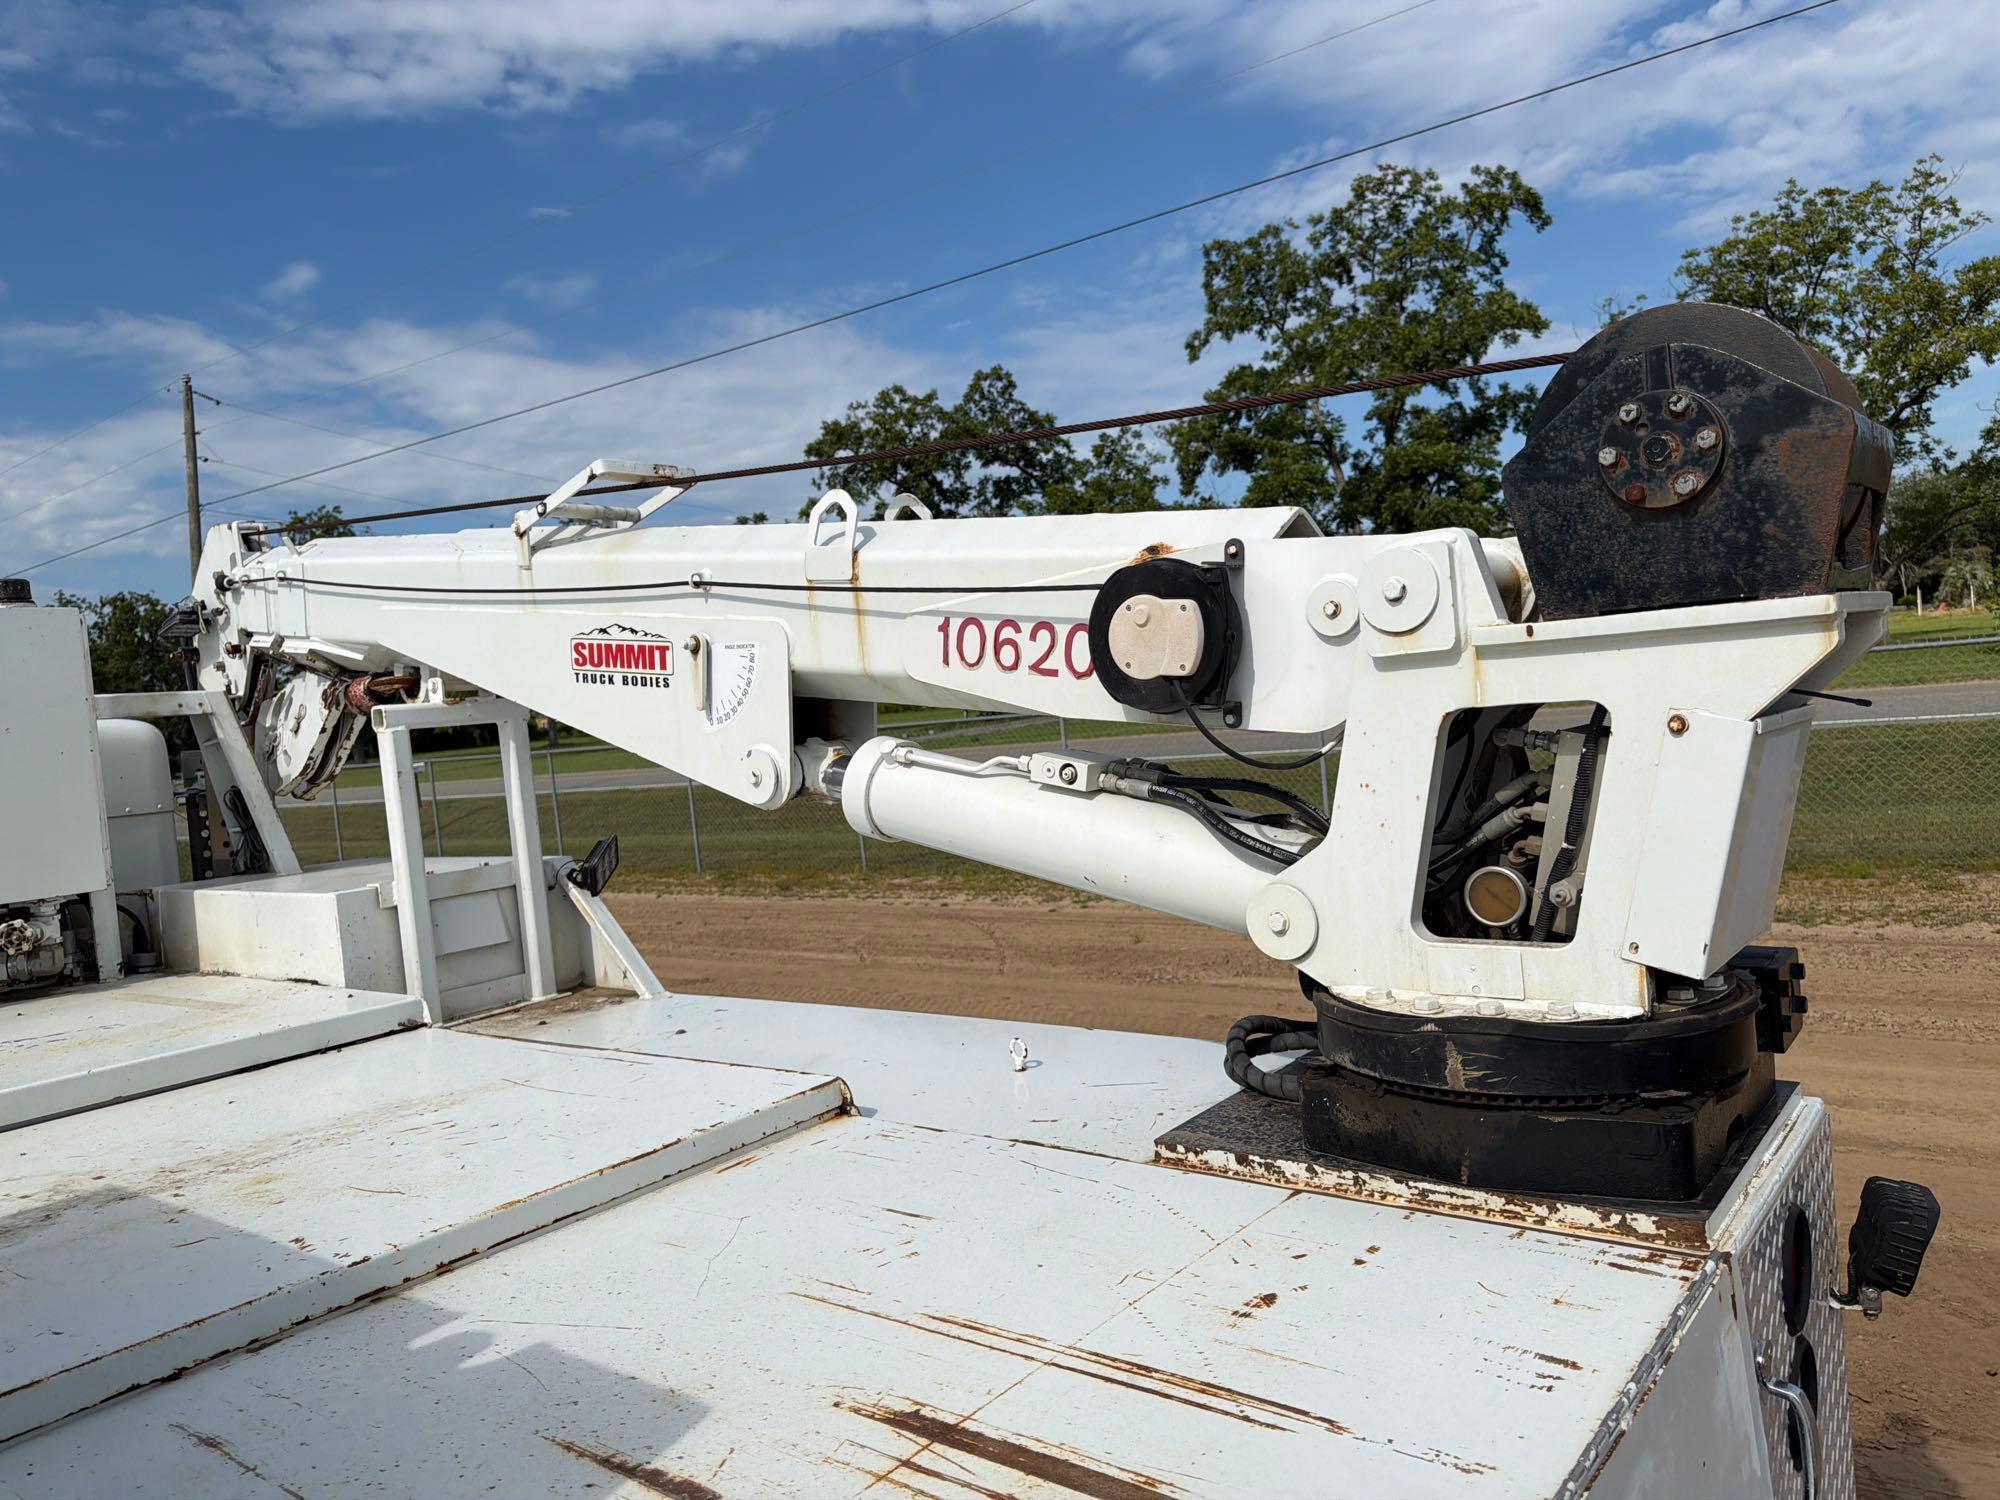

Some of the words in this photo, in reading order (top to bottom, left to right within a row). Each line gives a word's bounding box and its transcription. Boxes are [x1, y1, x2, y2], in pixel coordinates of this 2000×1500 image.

[937, 616, 1095, 680] 10620
[573, 642, 670, 671] SUMMIT
[749, 652, 755, 664] 80
[748, 665, 755, 676] 70
[574, 673, 615, 685] TRUCK
[622, 675, 670, 688] BODIES
[746, 677, 752, 688] 60
[742, 688, 749, 699] 50
[737, 697, 744, 707] 40
[730, 705, 738, 716] 30
[717, 716, 723, 725] 10
[724, 712, 731, 722] 20
